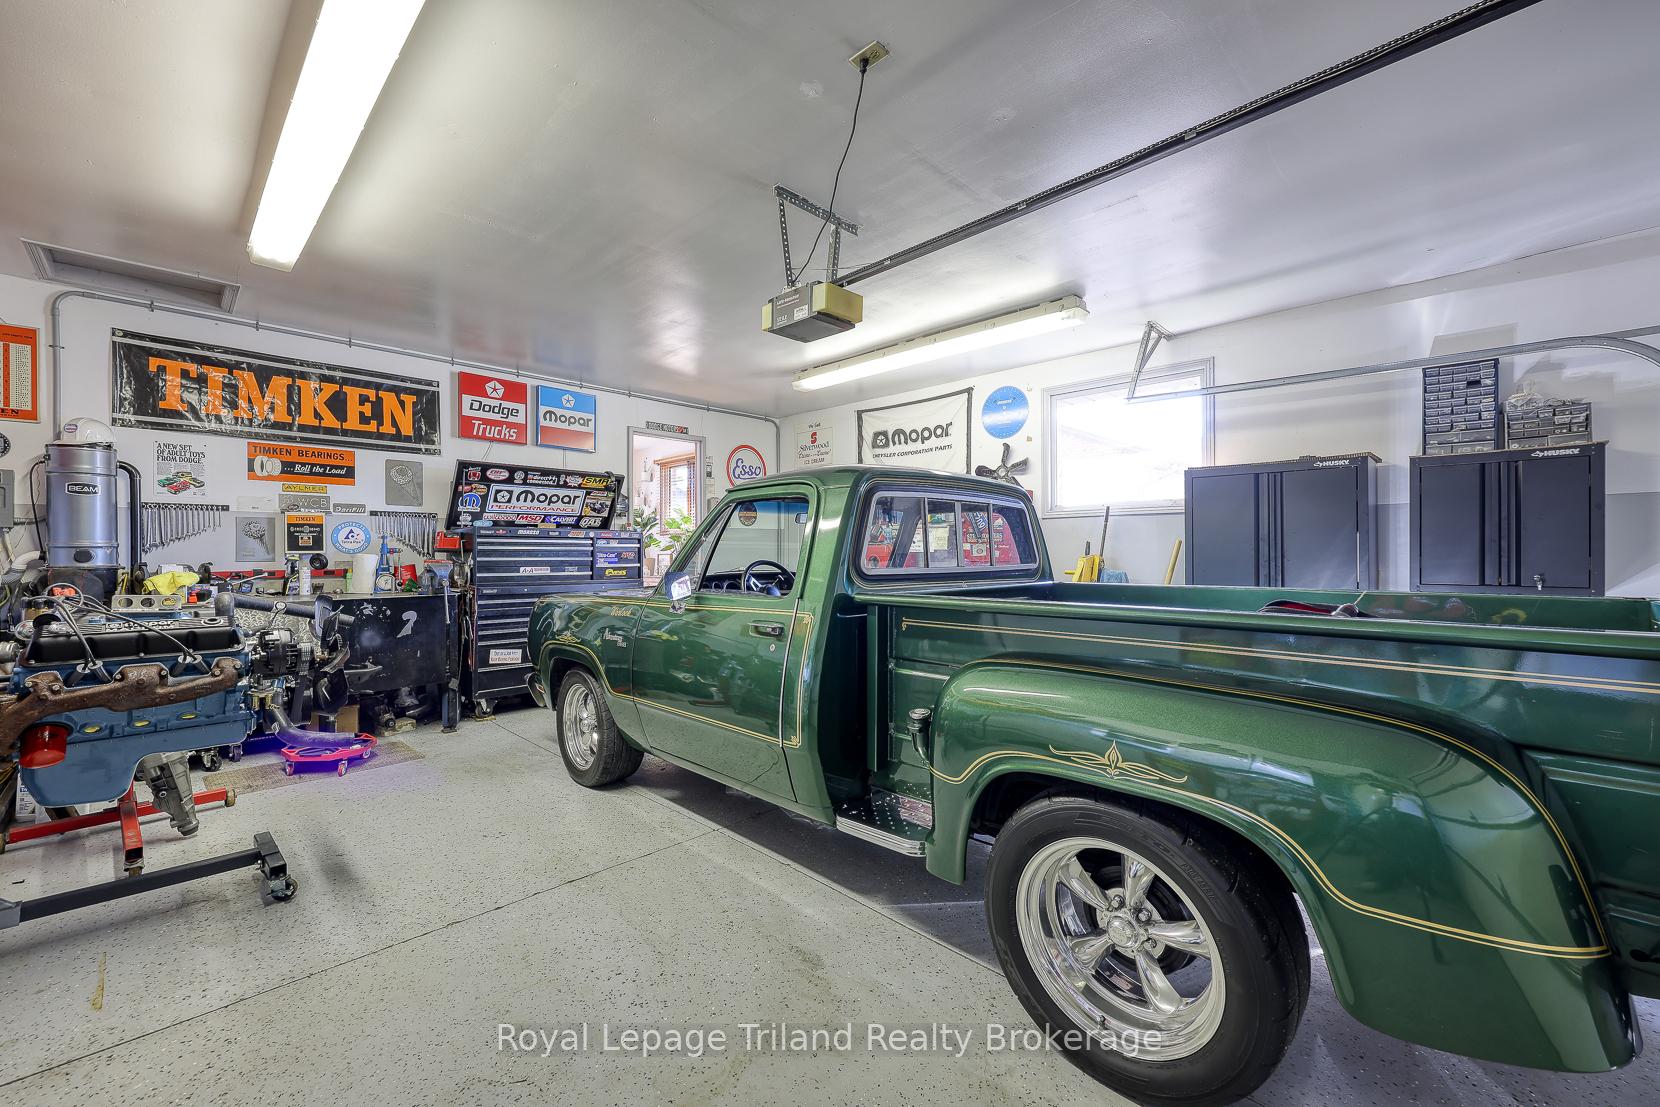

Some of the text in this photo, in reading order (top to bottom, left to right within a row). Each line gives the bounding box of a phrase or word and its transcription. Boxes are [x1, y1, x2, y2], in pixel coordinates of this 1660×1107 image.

[149, 356, 417, 436] TIMKEN
[469, 399, 520, 419] Dodge
[542, 409, 593, 428] Mopar
[471, 420, 518, 440] Trucks
[891, 421, 953, 447] Mopar
[252, 446, 292, 457] TIMKEN
[872, 444, 953, 459] CHRYSLER CORPORATION PARTS
[1543, 448, 1581, 458] HUSKY
[312, 465, 324, 473] the
[325, 466, 347, 475] Load
[732, 458, 761, 479] Esso
[1322, 459, 1350, 467] HUSKY
[68, 485, 99, 493] BEAM
[516, 489, 580, 506] Mopar
[490, 504, 577, 513] PERFORMANCE
